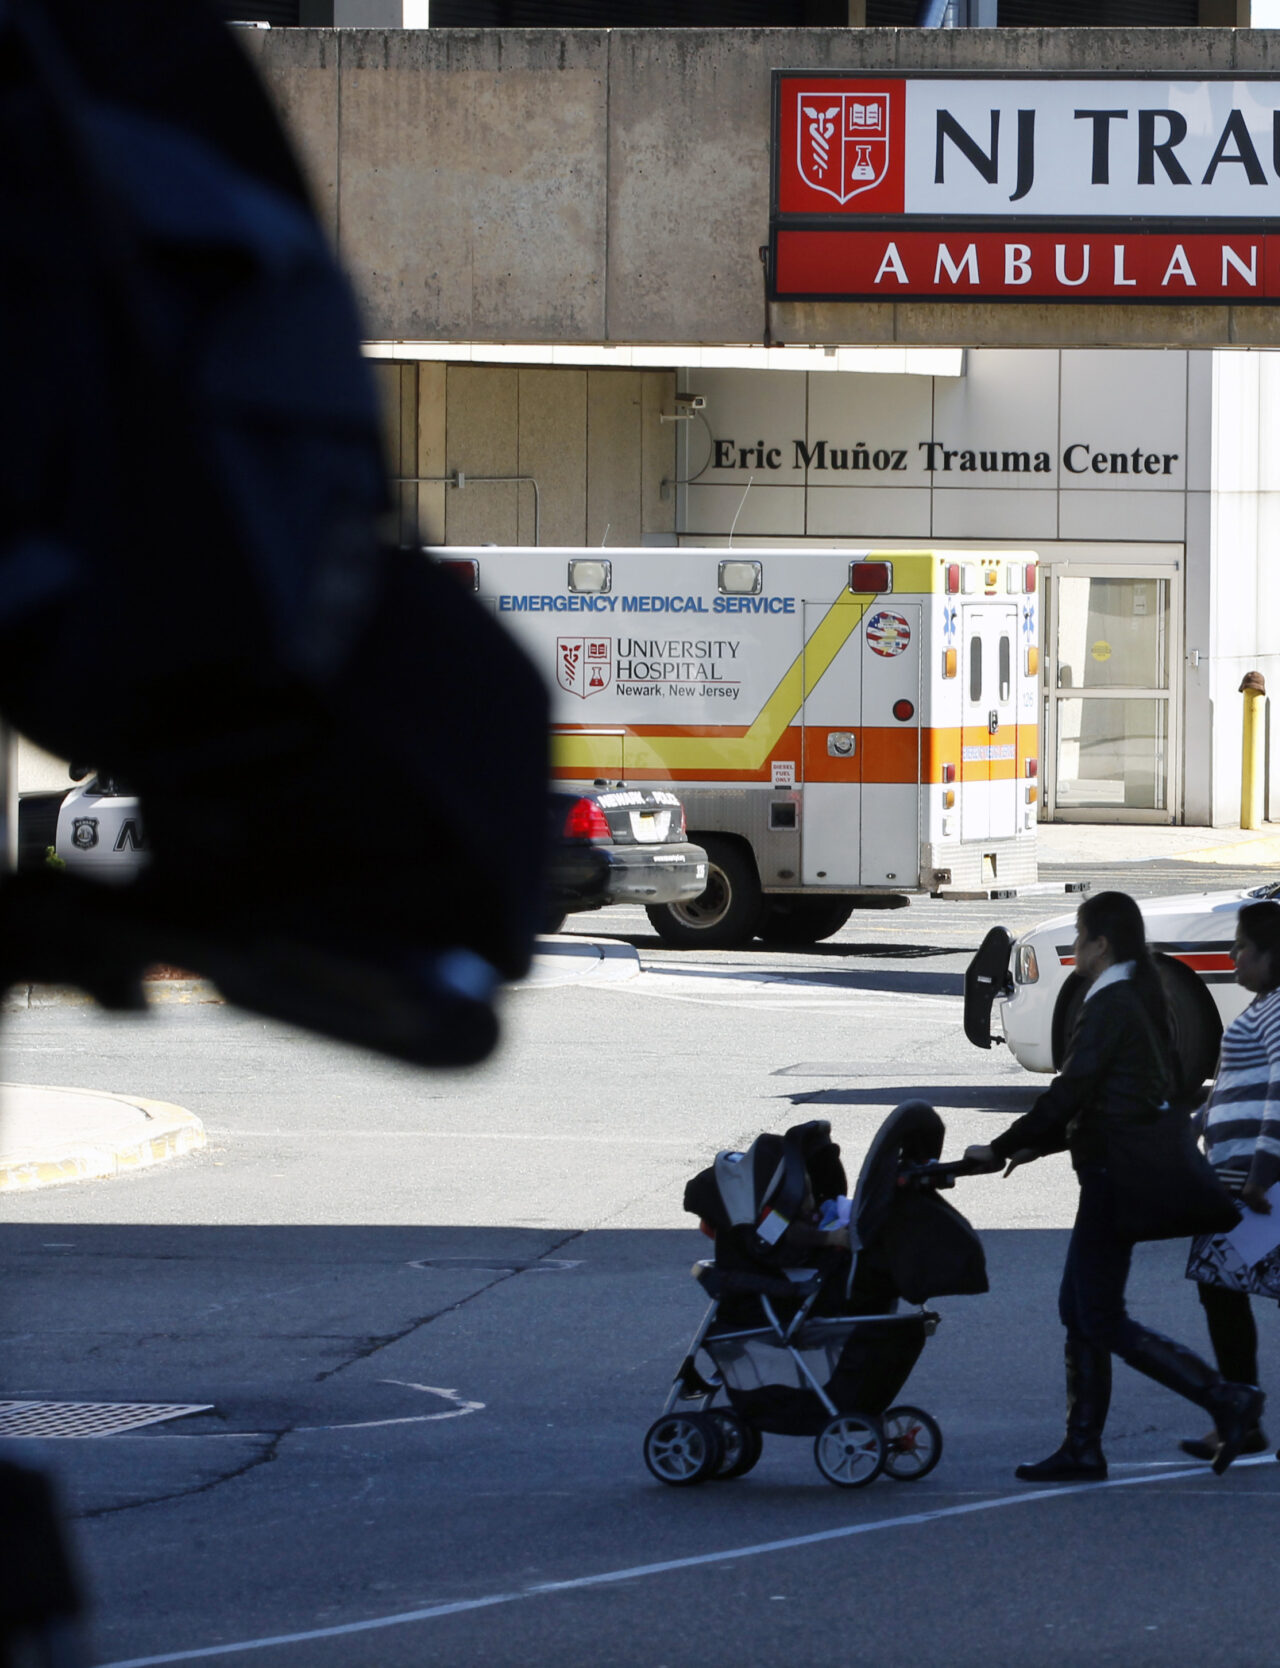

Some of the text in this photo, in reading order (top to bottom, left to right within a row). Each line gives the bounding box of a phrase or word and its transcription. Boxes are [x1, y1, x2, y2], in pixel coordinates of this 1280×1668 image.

[934, 108, 1036, 202] NJ
[712, 439, 1179, 475] Eric Muñoz Trauma Center
[500, 594, 796, 614] EMERGENCY MEDICAL SERVICE
[616, 637, 741, 659] UNIVERSITY
[616, 660, 723, 680] HOSPITAL
[616, 683, 740, 700] Newark, New Jersey
